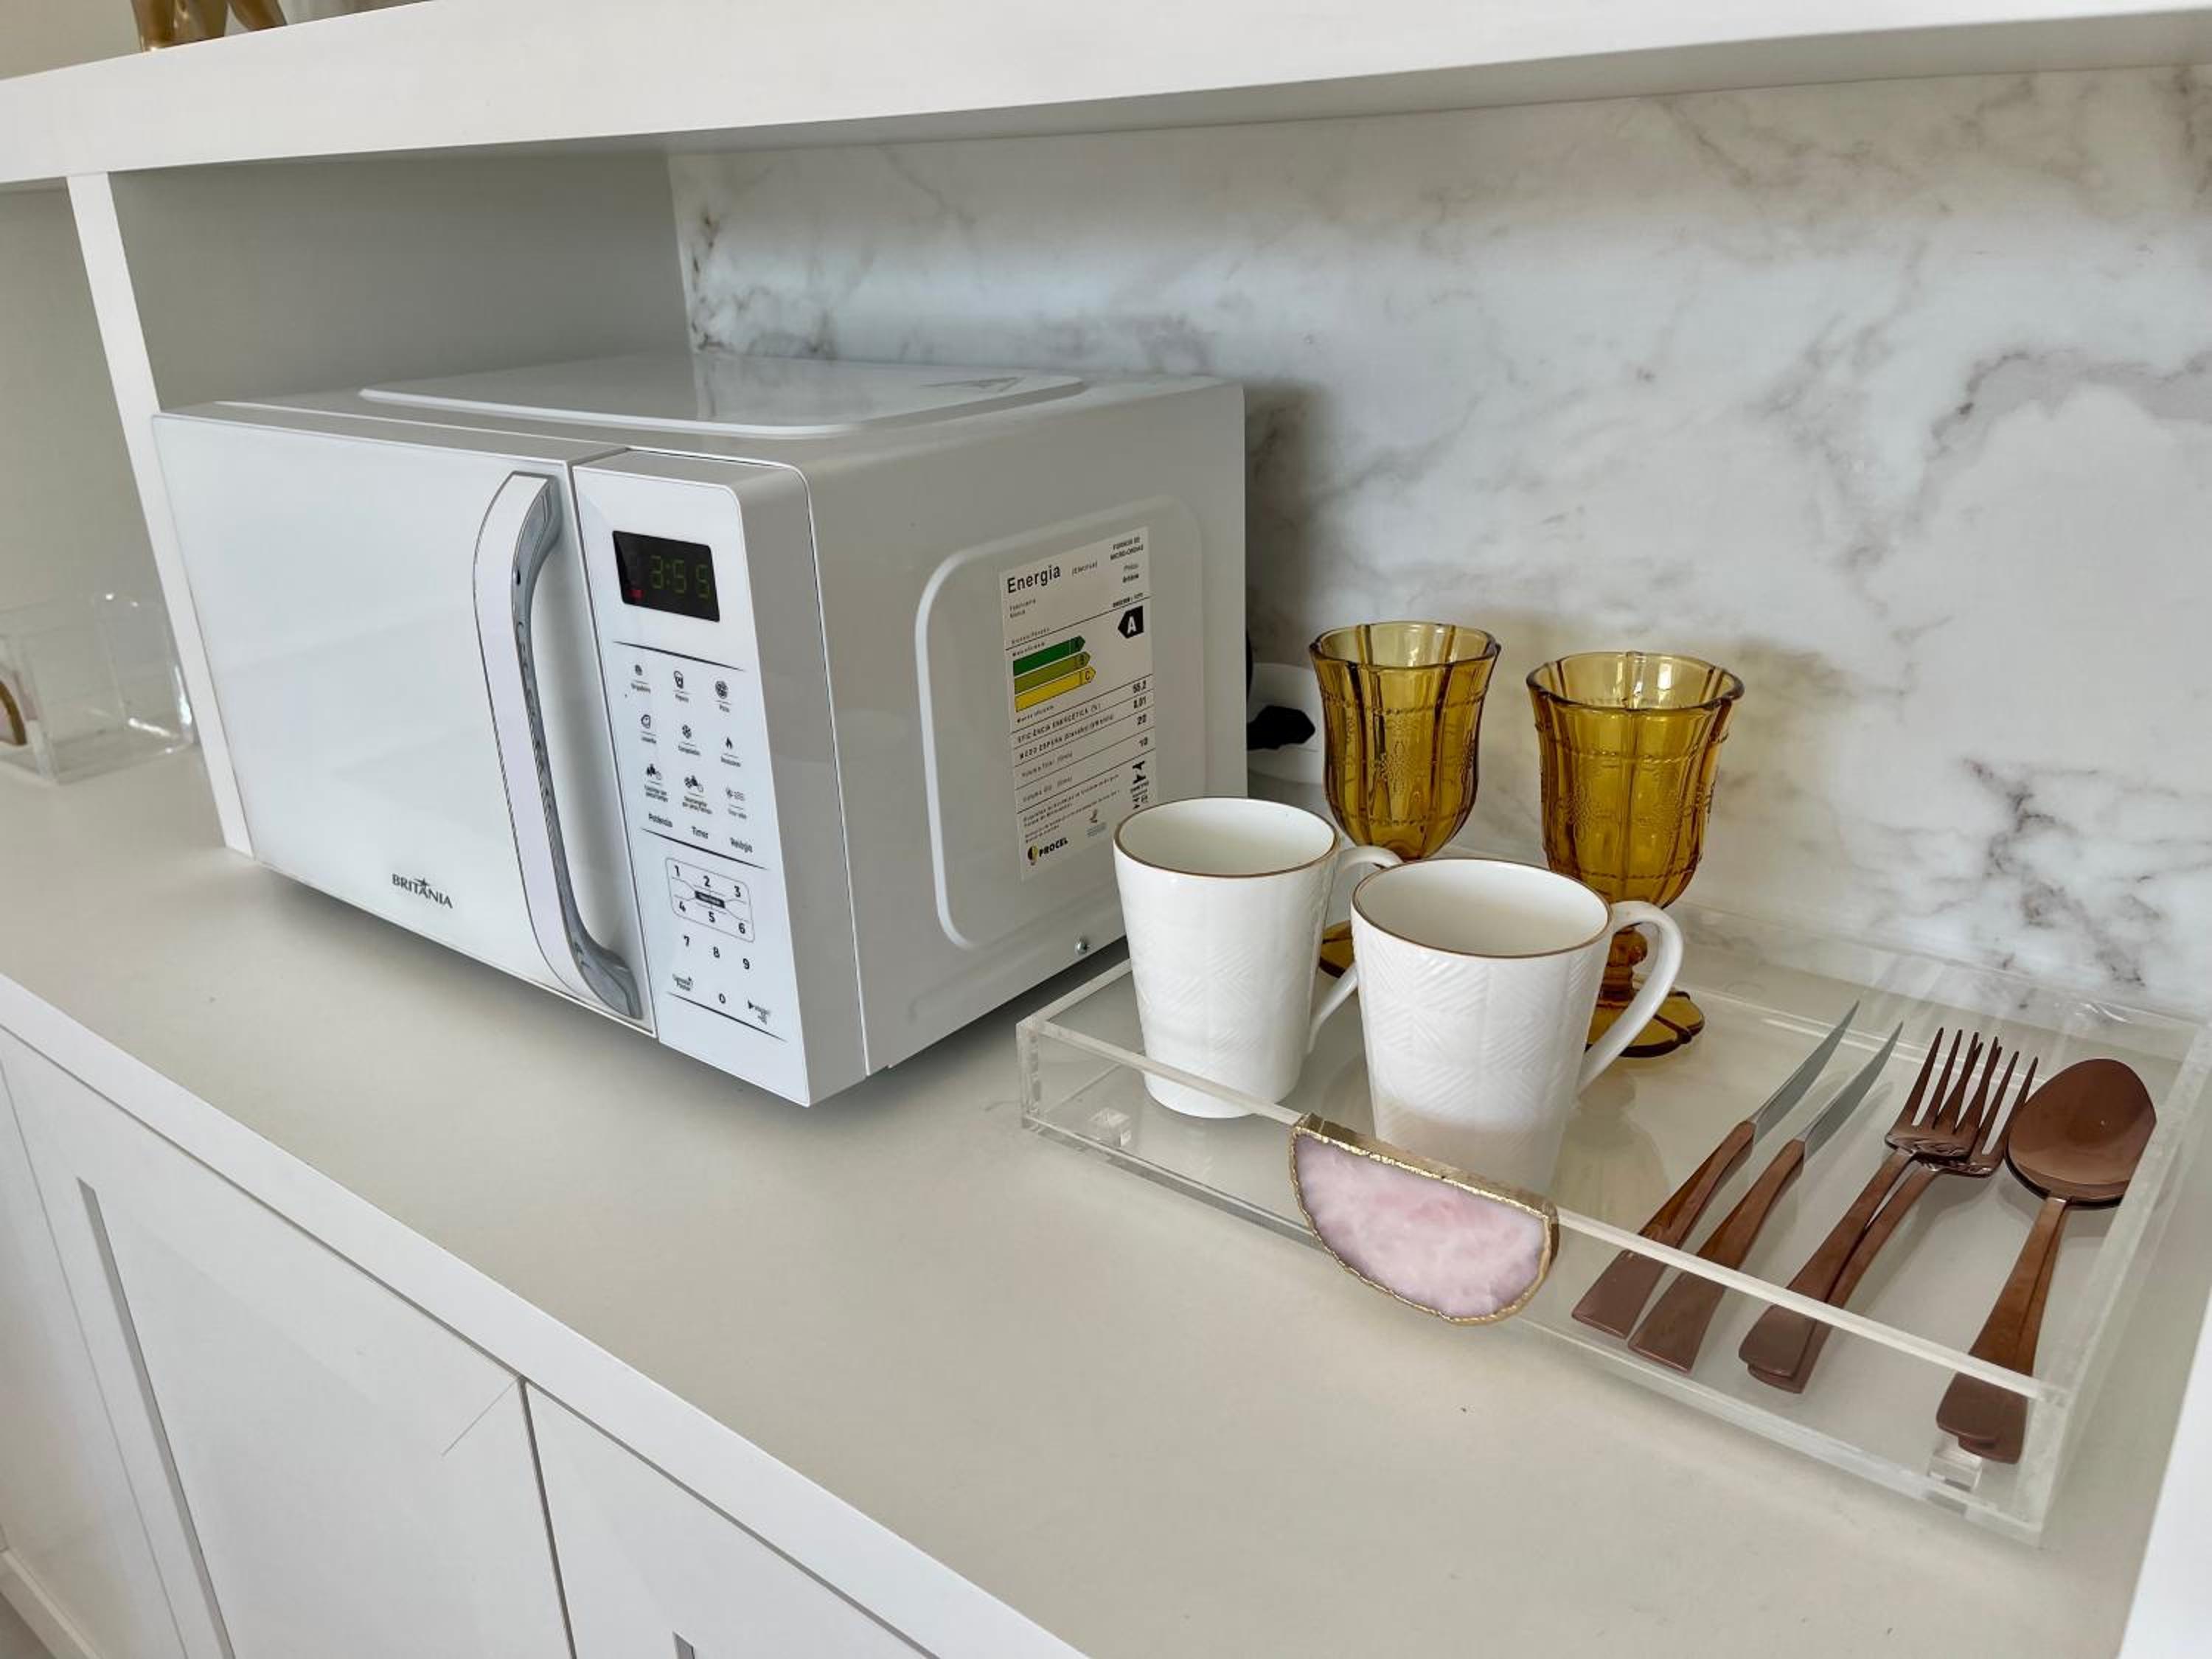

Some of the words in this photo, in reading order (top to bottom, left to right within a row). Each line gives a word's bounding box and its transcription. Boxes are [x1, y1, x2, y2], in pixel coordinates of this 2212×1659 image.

[1007, 565, 1061, 594] Energia
[1127, 616, 1137, 634] A
[1085, 670, 1091, 681] C
[1039, 837, 1068, 857] PROCEL
[674, 865, 680, 877] 1
[703, 875, 711, 887] 2
[734, 886, 741, 897] 3
[679, 900, 686, 912] 4
[708, 911, 715, 922] 5
[738, 922, 745, 934] 6
[684, 935, 689, 947] 7
[713, 946, 720, 959] 8
[742, 958, 750, 970] 9
[719, 993, 726, 1004] 0
